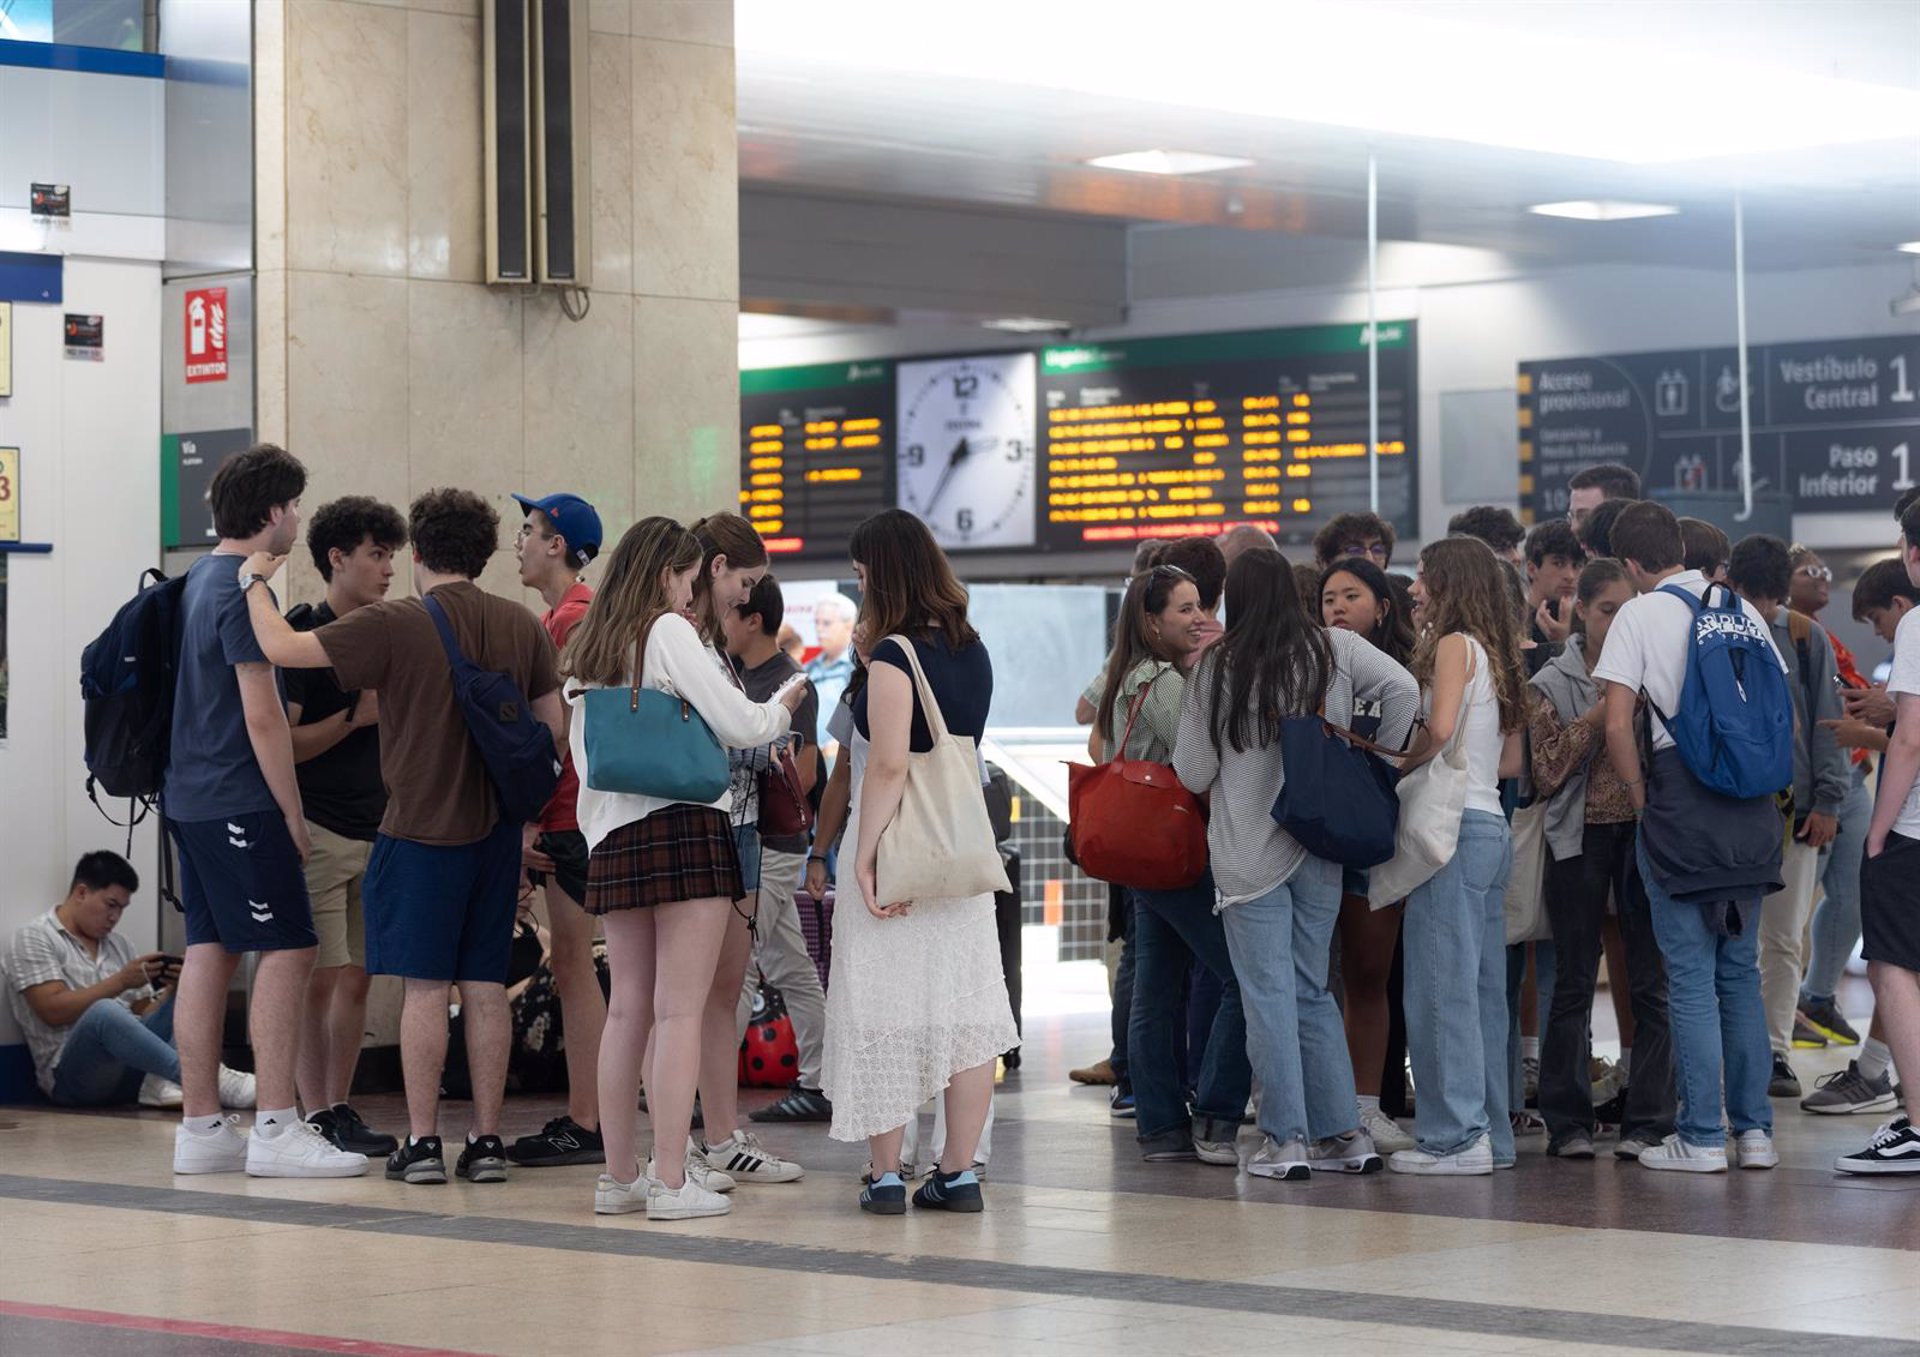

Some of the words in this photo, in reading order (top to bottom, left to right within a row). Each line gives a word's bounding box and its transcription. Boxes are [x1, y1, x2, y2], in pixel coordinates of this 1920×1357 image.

[186, 361, 227, 377] EXTINTOR
[1779, 355, 1878, 383] Vestíbulo
[953, 376, 978, 398] 12
[1539, 371, 1592, 391] Acceso
[1539, 388, 1630, 416] provisional
[1804, 383, 1878, 410] Central
[908, 446, 924, 467] 9
[1006, 441, 1022, 461] 3
[1829, 443, 1878, 467] Paso
[1891, 443, 1915, 490] 1
[1799, 470, 1878, 496] Inferior
[957, 510, 972, 532] 6
